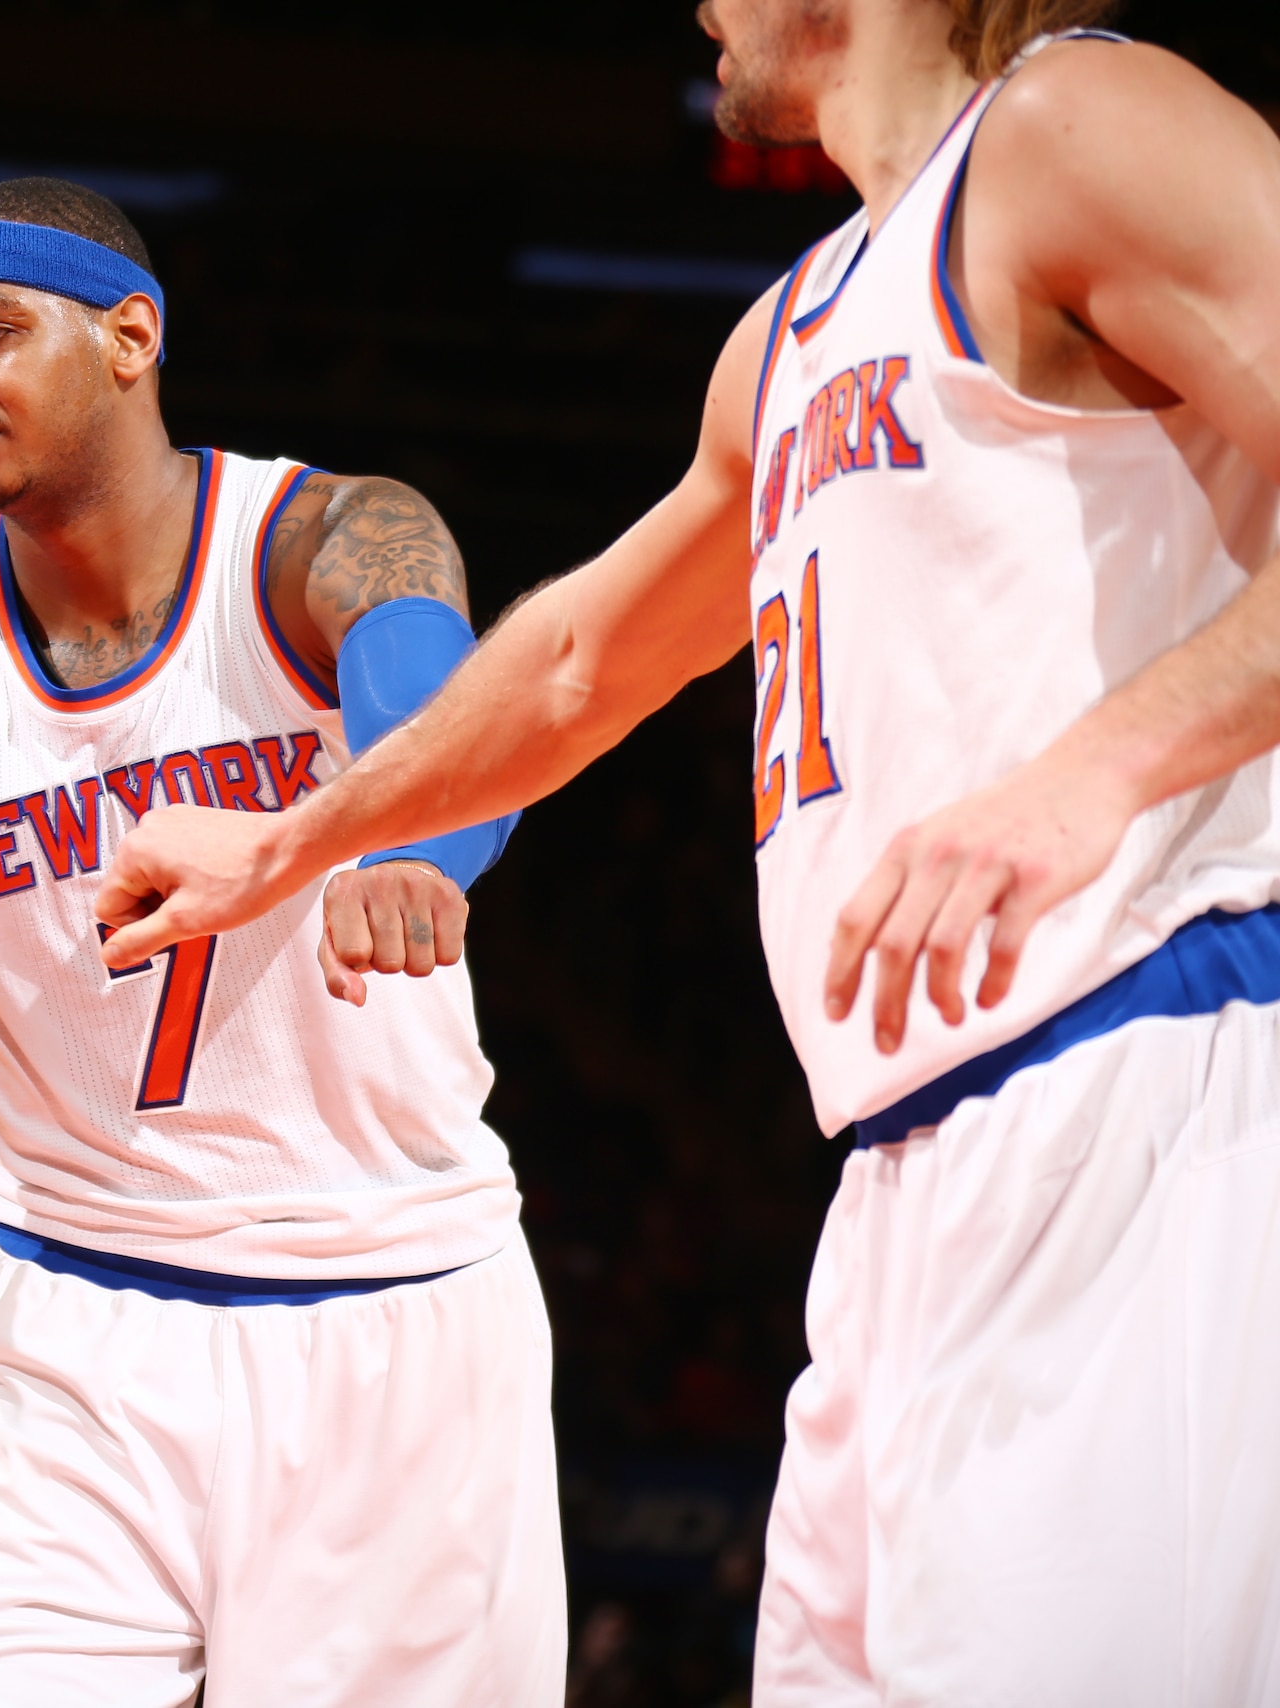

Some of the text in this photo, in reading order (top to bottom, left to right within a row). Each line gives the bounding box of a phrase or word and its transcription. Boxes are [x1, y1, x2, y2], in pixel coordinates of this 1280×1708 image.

[102, 731, 325, 828] YORK
[755, 547, 843, 853] 21
[96, 922, 219, 1111] 7
